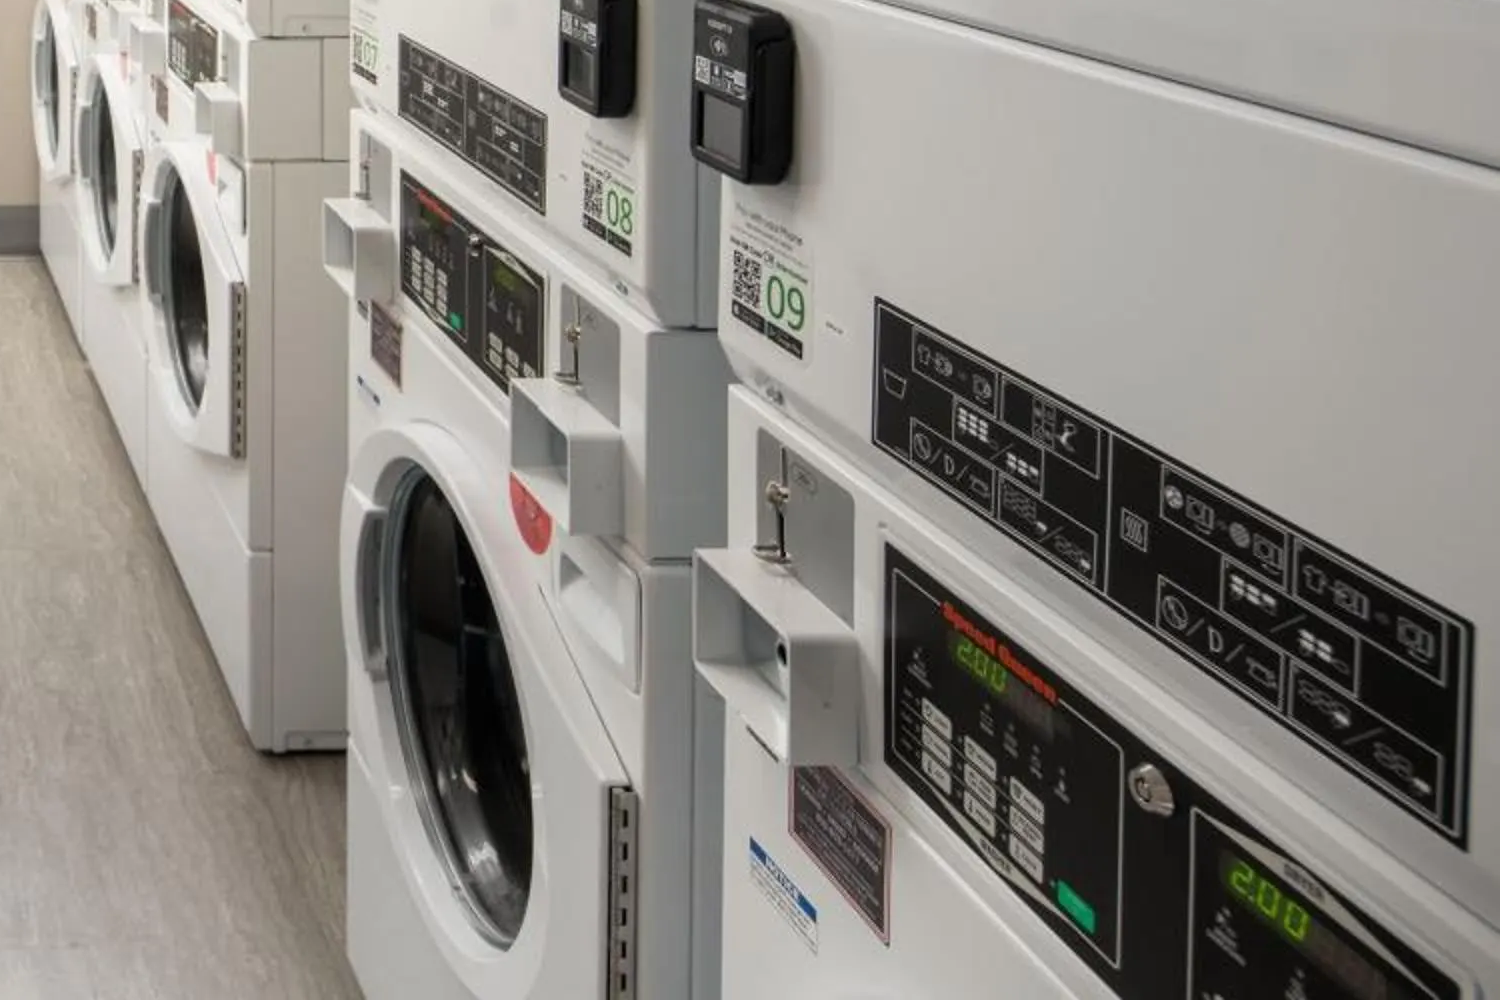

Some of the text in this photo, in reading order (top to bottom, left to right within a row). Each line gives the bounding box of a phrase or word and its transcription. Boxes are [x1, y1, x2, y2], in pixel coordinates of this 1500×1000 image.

[607, 189, 633, 236] 08
[767, 275, 805, 331] 09
[939, 601, 998, 656] Speed
